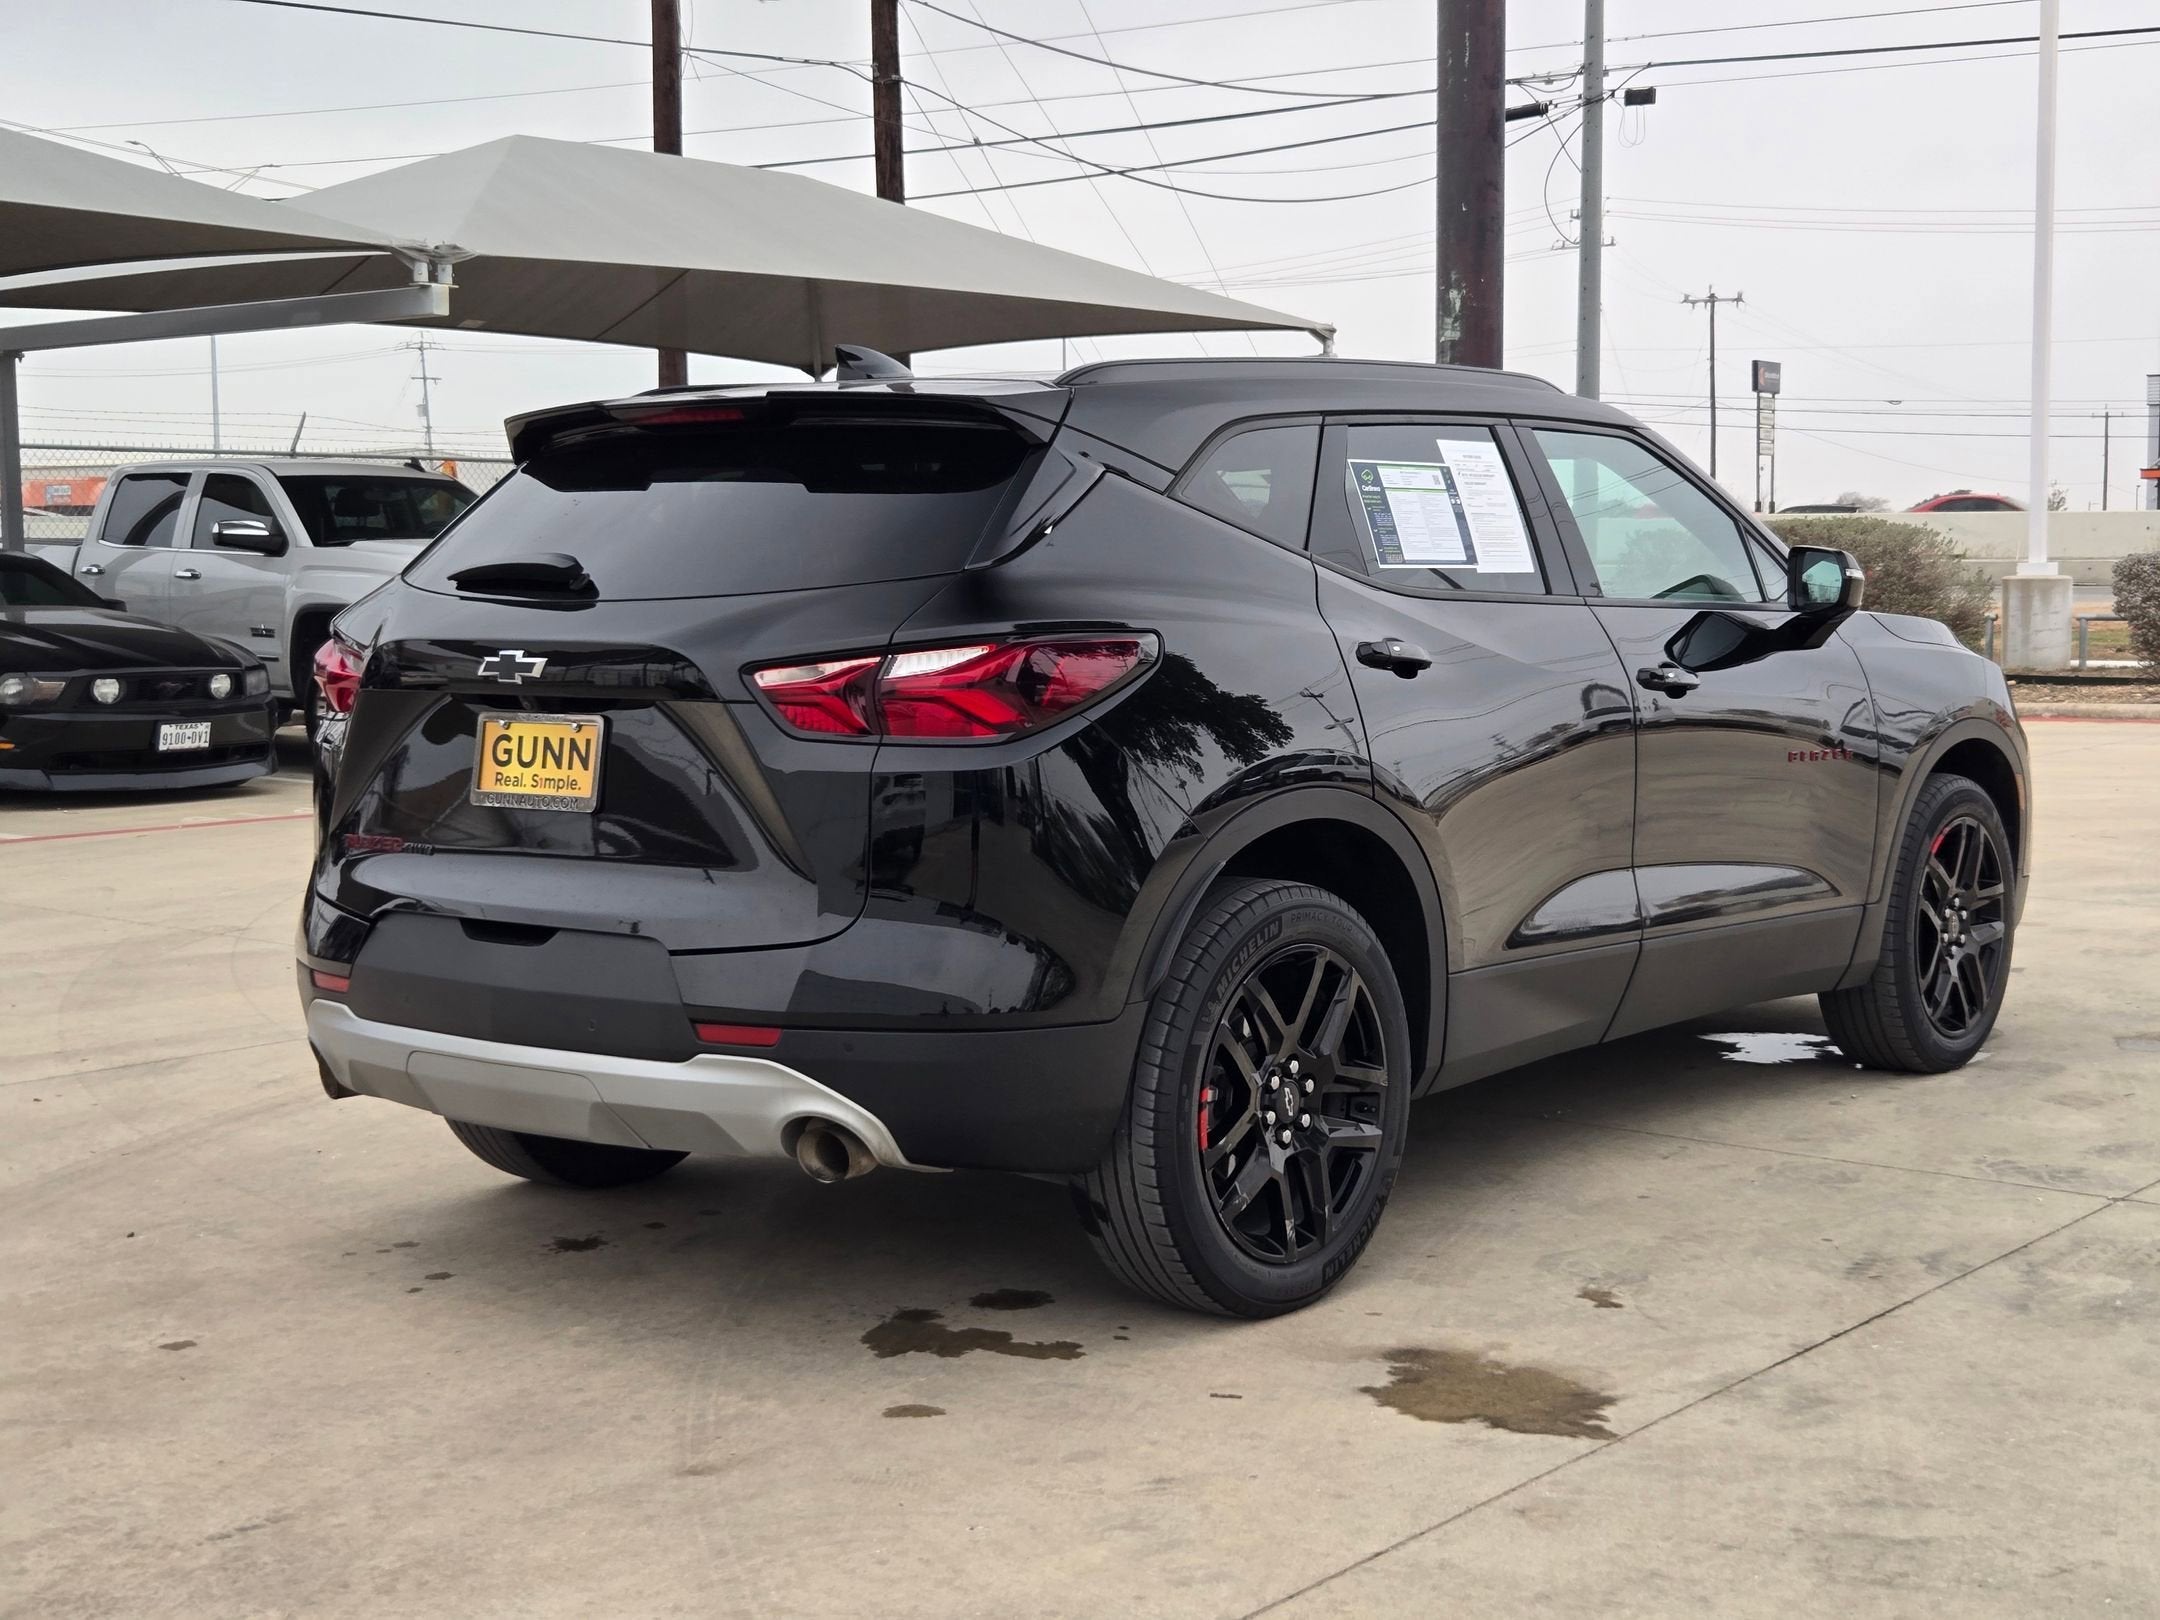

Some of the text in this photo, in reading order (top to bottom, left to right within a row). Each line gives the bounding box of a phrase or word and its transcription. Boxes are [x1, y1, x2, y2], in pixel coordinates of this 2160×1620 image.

[492, 734, 592, 771] GUNN
[495, 772, 527, 788] Real.
[486, 794, 579, 809] GUNNAUTO.COM
[1290, 911, 1329, 923] PRIMACY
[1215, 919, 1282, 998] MICHELIN
